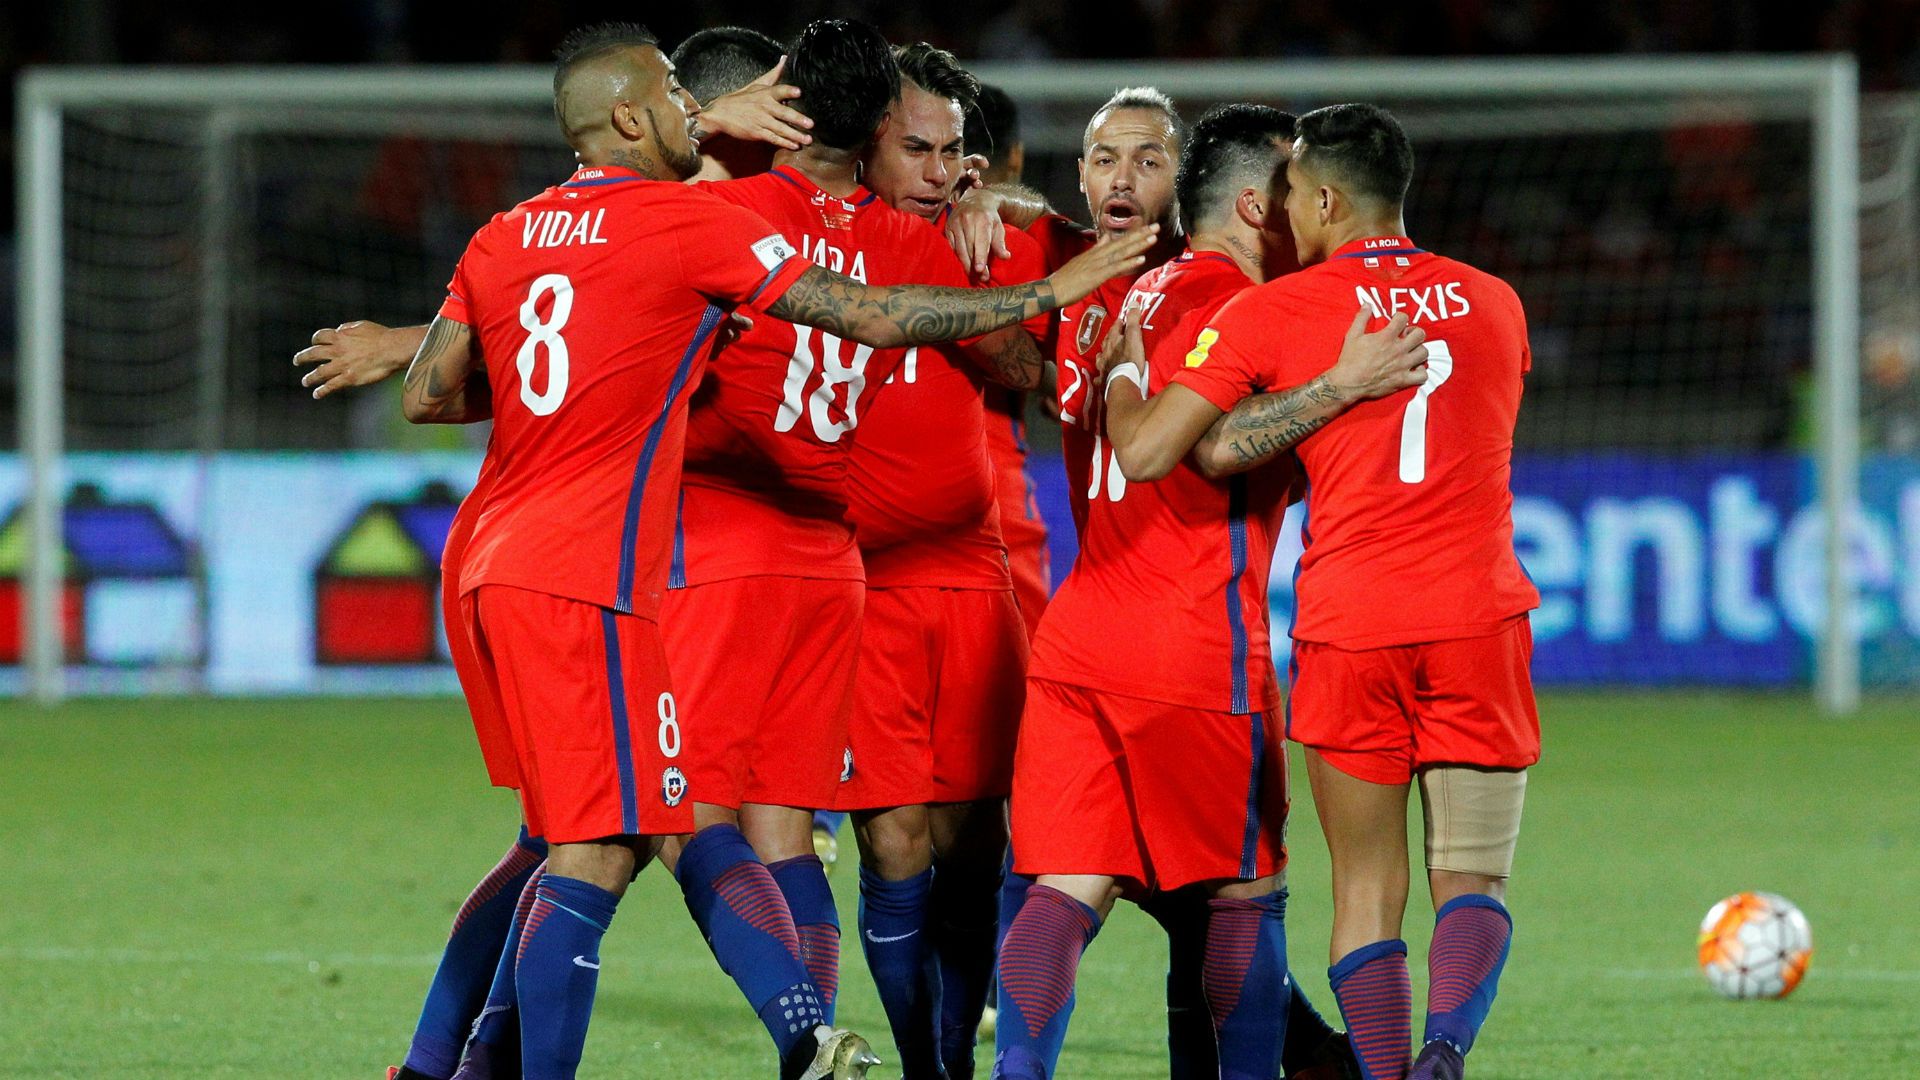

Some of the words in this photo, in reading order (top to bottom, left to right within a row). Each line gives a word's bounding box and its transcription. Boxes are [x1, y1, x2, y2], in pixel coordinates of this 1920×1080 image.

[578, 172, 585, 180] LA
[586, 169, 604, 179] ROJA
[522, 207, 608, 249] VIDAL
[1379, 239, 1400, 247] ROJA
[516, 273, 574, 416] 8
[773, 323, 875, 443] 18
[1399, 339, 1453, 484] 7
[657, 691, 681, 758] 8
